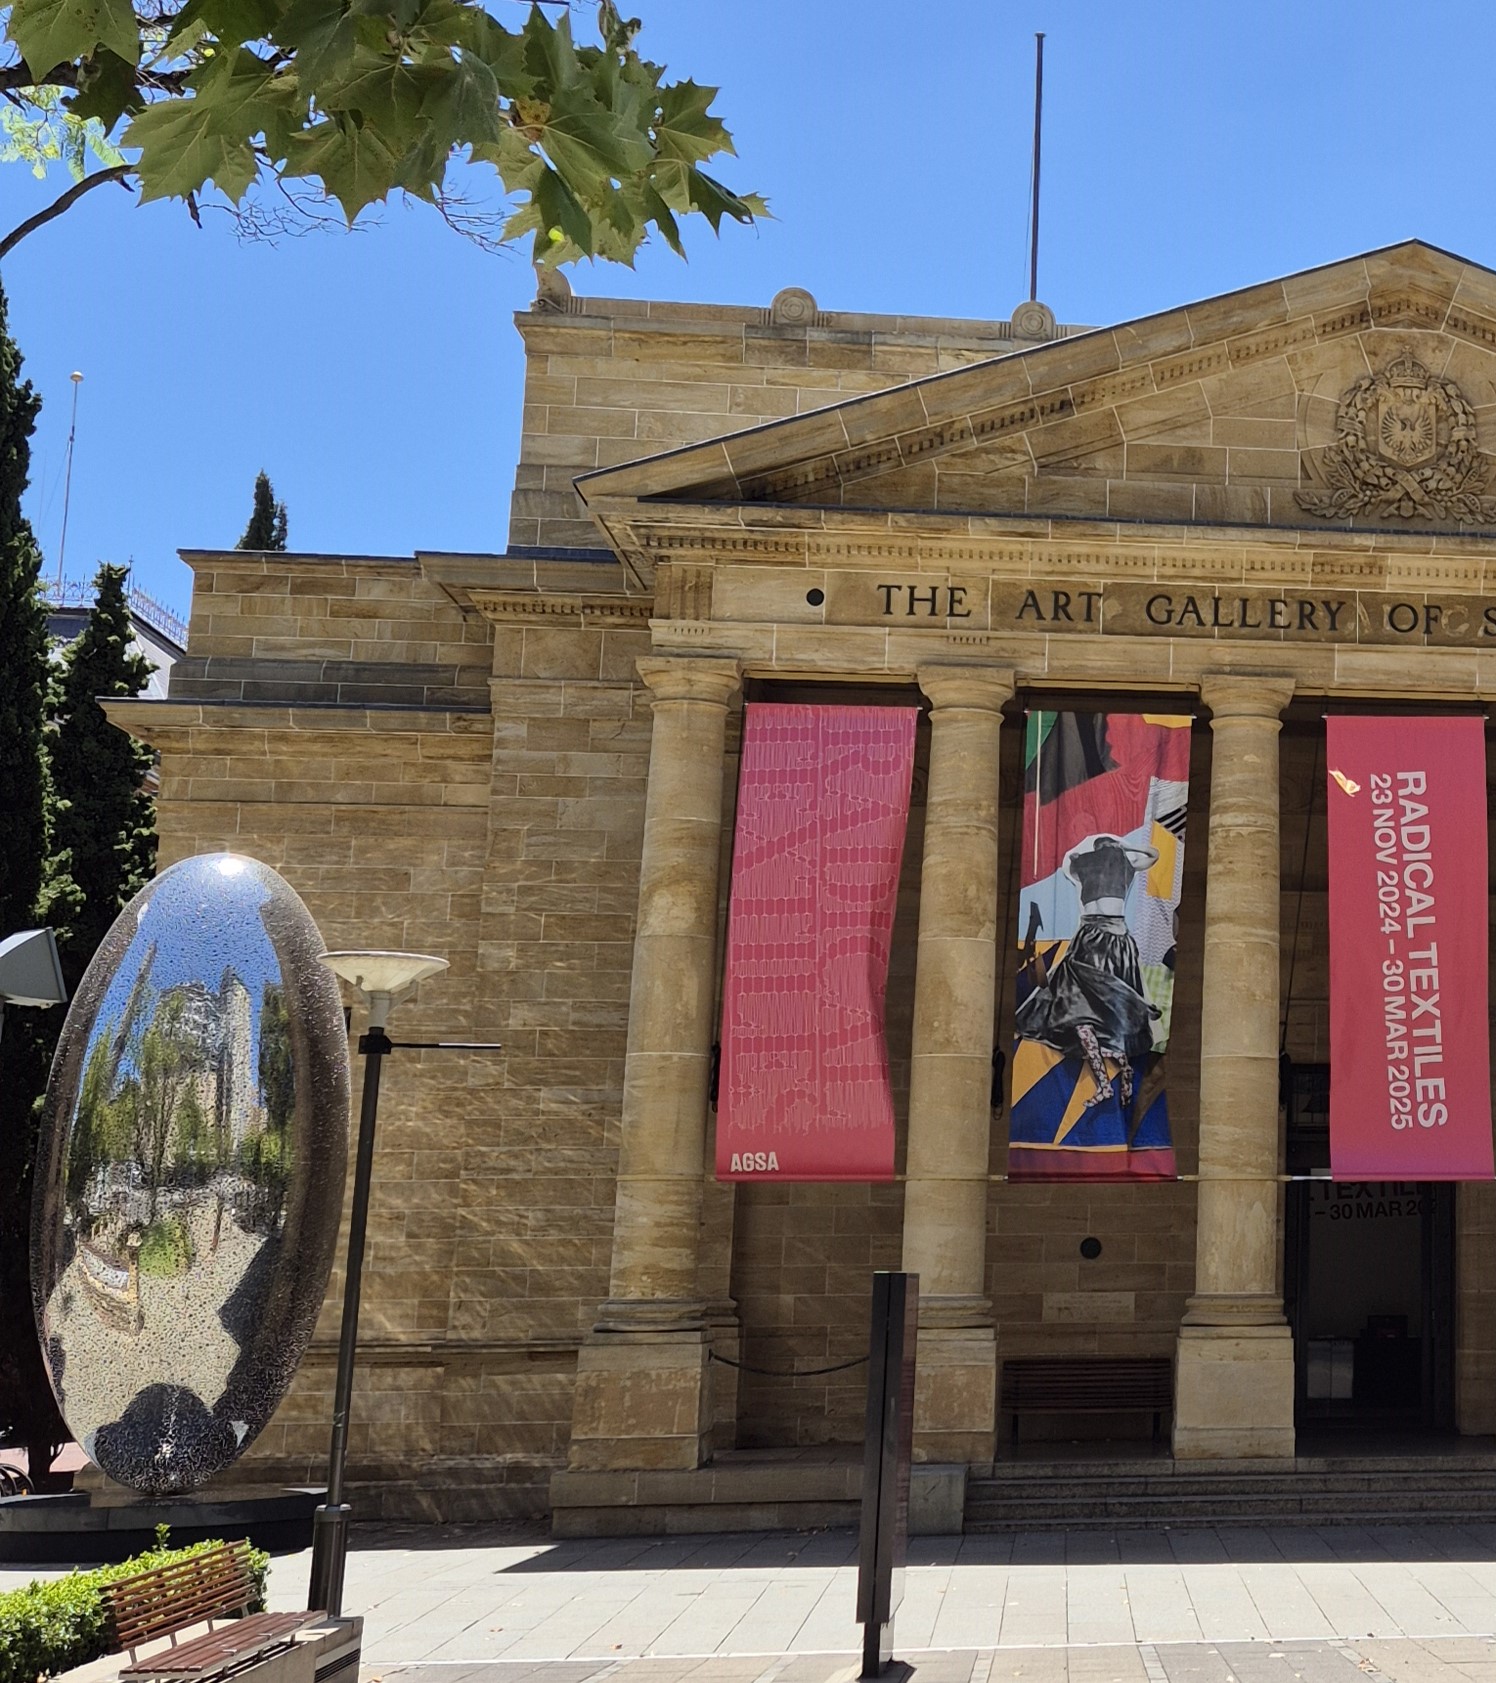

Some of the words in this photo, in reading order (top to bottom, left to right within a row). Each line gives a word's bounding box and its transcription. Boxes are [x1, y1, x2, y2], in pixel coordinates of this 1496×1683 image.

[877, 583, 971, 618] THE
[1016, 589, 1103, 623] ART
[1145, 594, 1347, 631] GALLERY
[1387, 602, 1443, 635] OF
[1370, 773, 1391, 805] 23
[1372, 808, 1397, 865] NOV
[1396, 770, 1435, 938] RADICAL
[1377, 871, 1401, 934] 2024
[1382, 959, 1405, 992] 30
[1384, 997, 1409, 1060] MAR
[1408, 941, 1448, 1129] TEXTILES
[1388, 1064, 1413, 1130] 2025
[730, 1151, 779, 1172] AGSA
[1318, 1182, 1425, 1201] TEXTIL
[1330, 1203, 1352, 1220] 30
[1357, 1200, 1402, 1219] MAR
